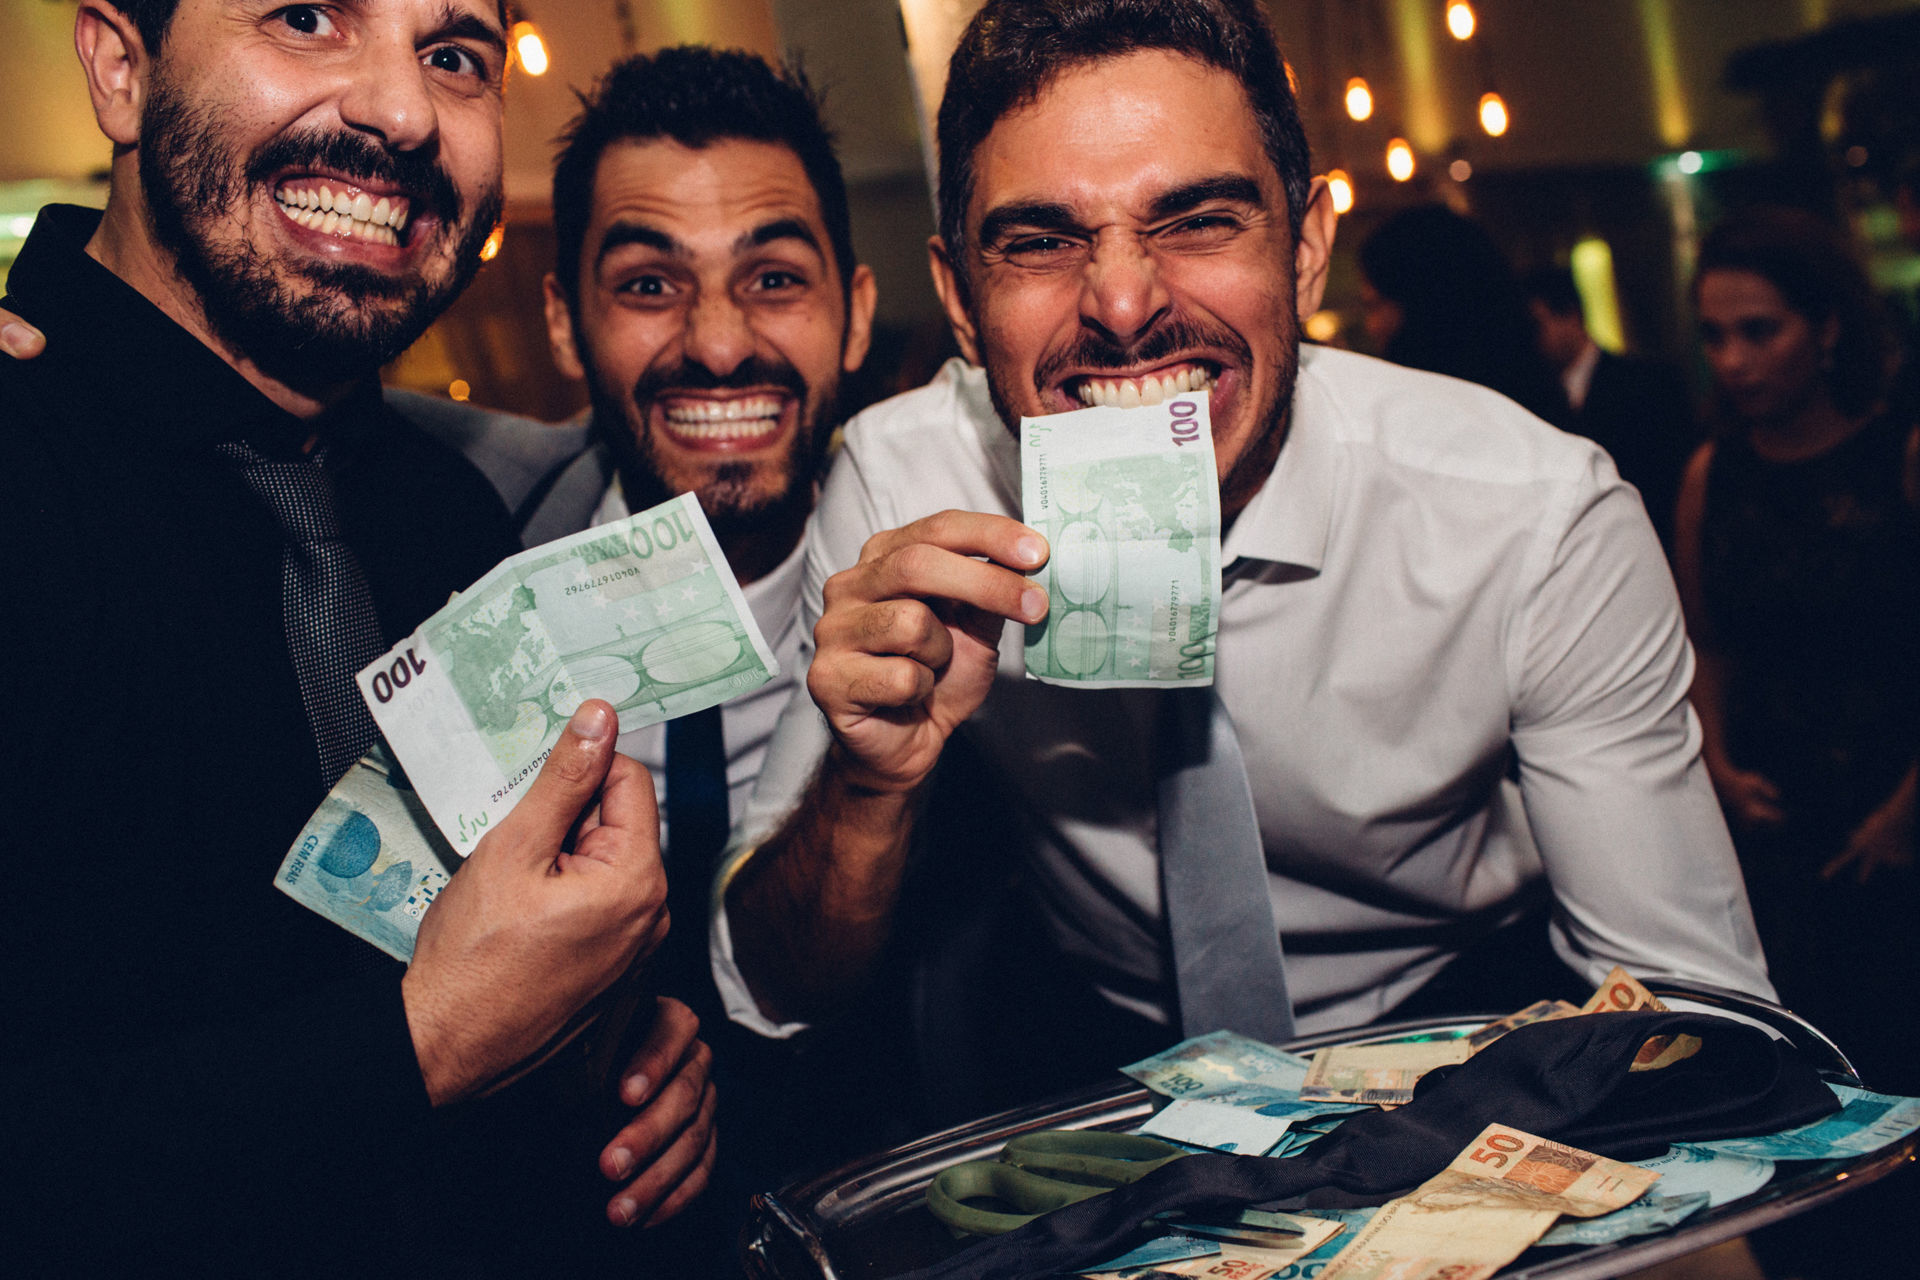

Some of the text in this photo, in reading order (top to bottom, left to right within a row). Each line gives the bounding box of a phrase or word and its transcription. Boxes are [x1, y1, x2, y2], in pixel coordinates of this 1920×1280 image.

[1169, 401, 1200, 447] 100
[629, 511, 695, 559] 100
[565, 567, 640, 596] V04016779762
[1169, 579, 1180, 642] V04016779771
[371, 647, 428, 704] 100
[1178, 641, 1207, 679] 100
[491, 748, 553, 803] V04016779762
[285, 835, 319, 885] CEM REAIS
[1168, 1073, 1204, 1091] 100
[1469, 1134, 1525, 1169] 50
[1207, 1260, 1249, 1277] 50
